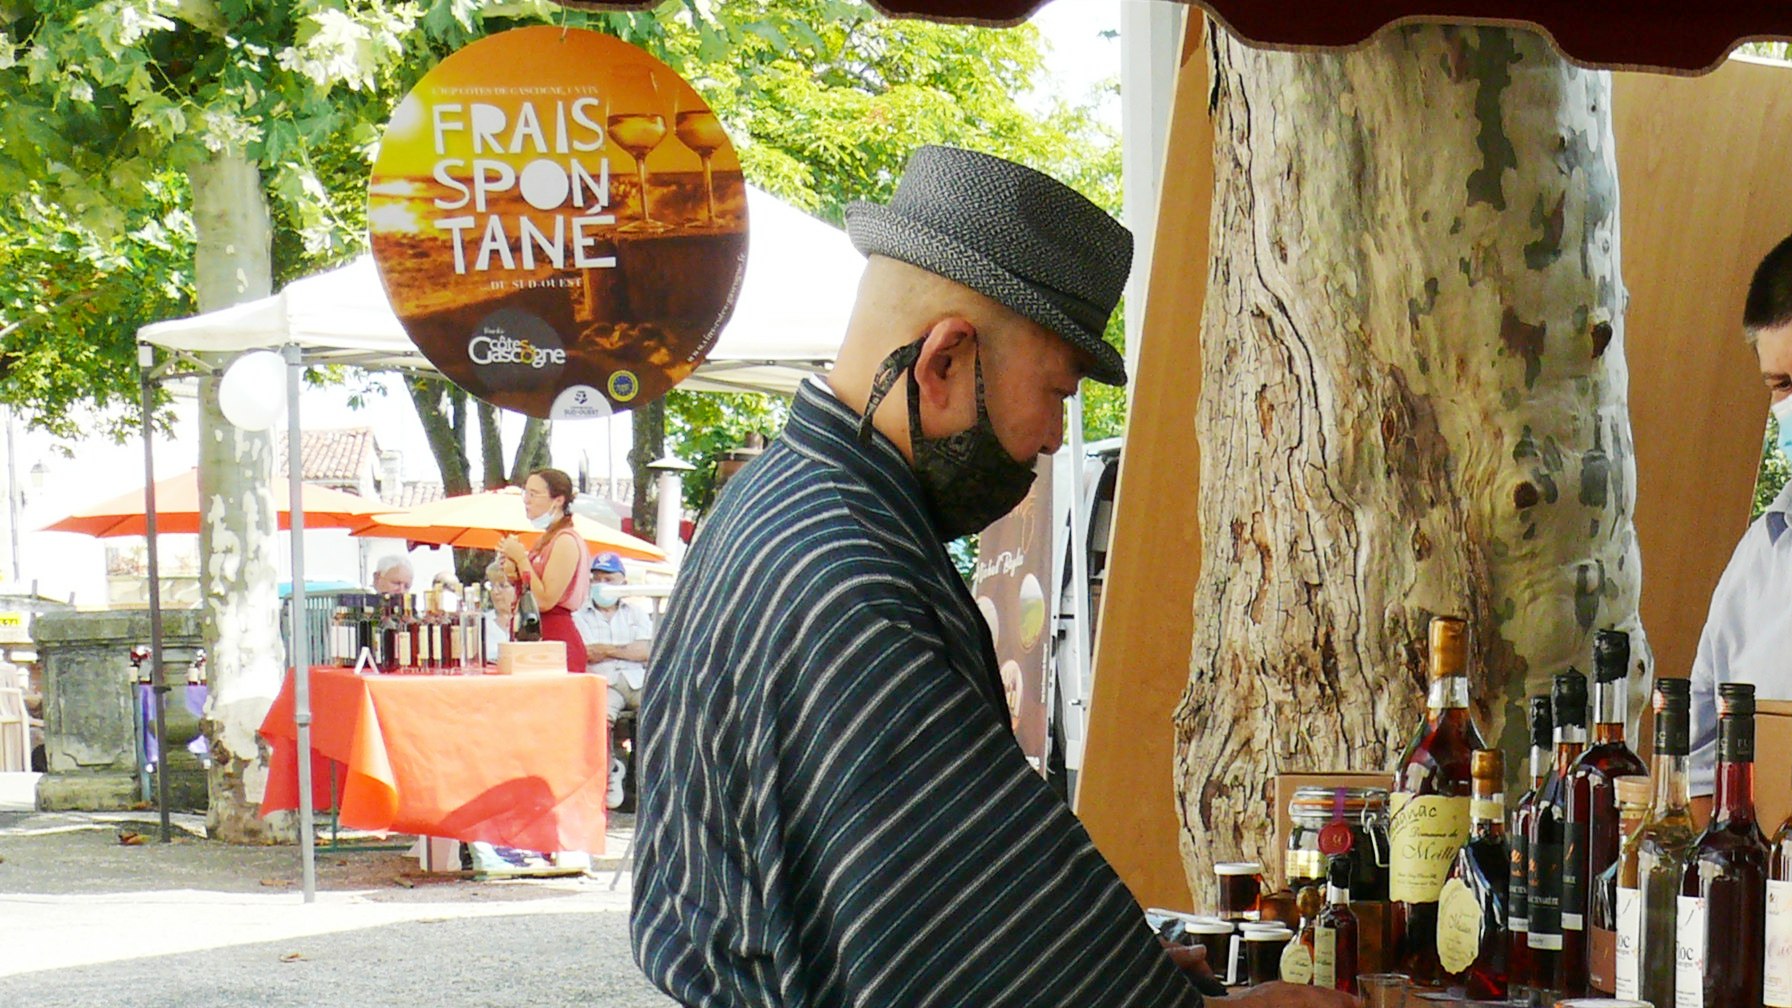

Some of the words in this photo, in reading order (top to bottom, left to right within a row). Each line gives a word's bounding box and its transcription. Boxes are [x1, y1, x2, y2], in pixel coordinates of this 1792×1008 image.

[432, 97, 604, 155] FRAIS
[433, 158, 609, 212] SPON
[433, 204, 617, 274] TANÉ
[468, 336, 566, 368] Gascogne
